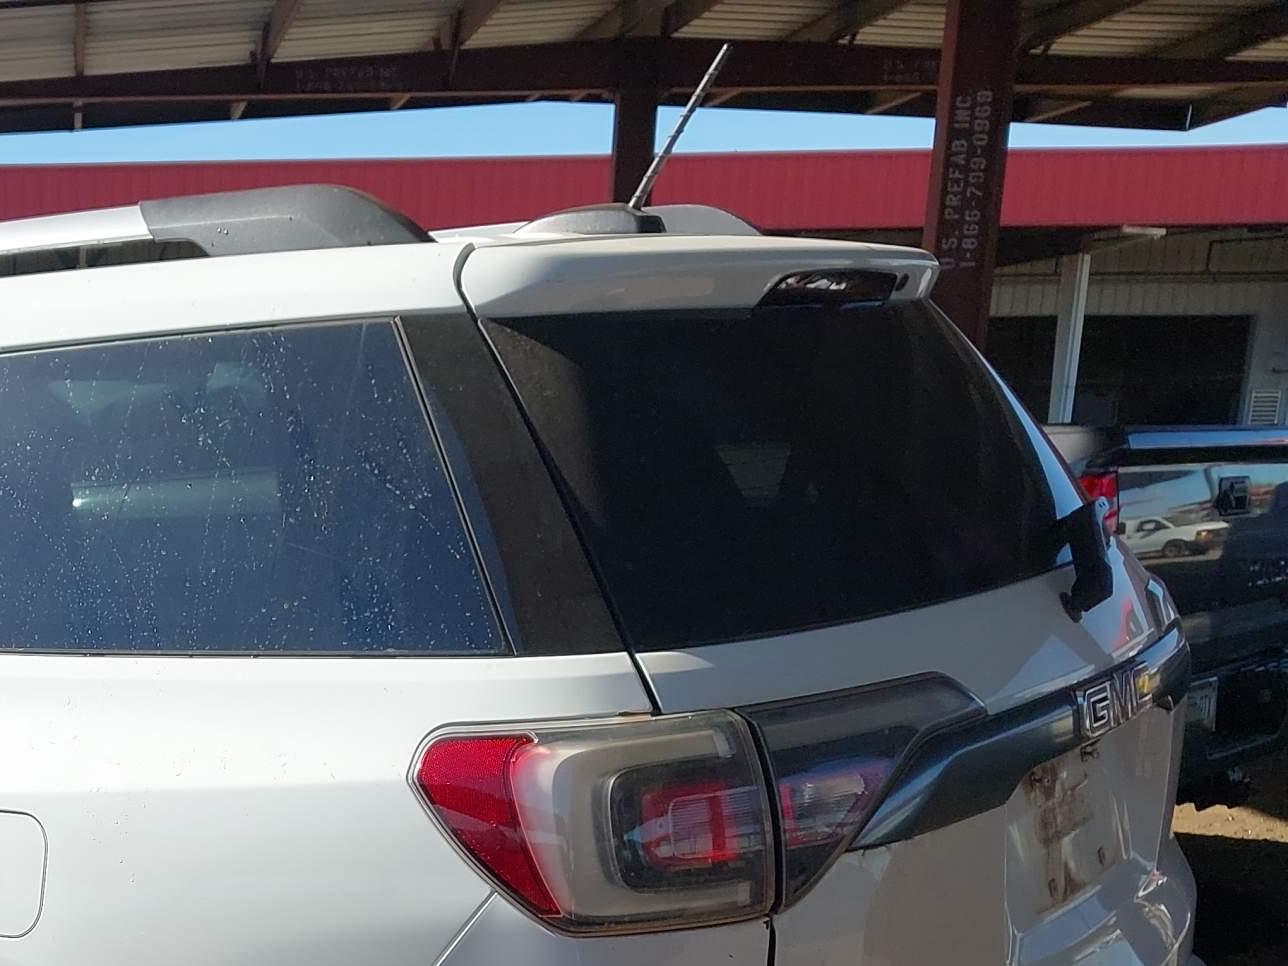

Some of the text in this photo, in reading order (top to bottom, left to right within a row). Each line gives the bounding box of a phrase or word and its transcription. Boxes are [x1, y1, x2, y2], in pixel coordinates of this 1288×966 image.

[953, 96, 972, 128] INC
[944, 139, 968, 220] PREFAB
[1082, 660, 1153, 738] GMC
